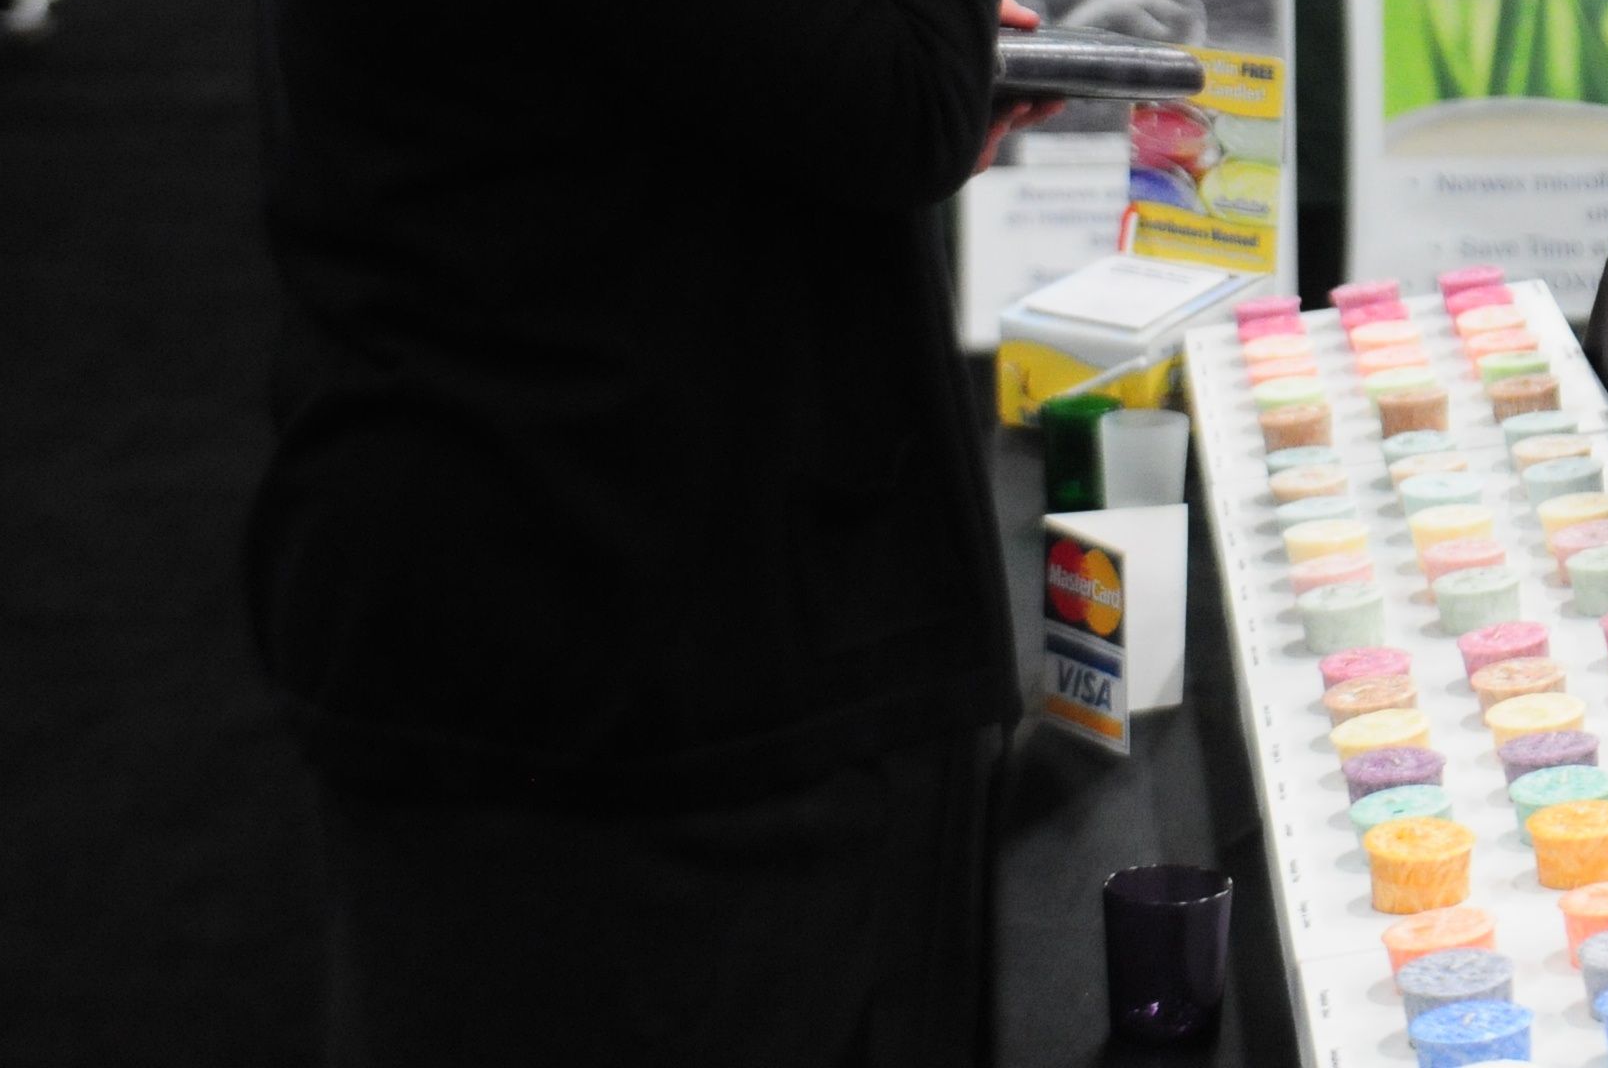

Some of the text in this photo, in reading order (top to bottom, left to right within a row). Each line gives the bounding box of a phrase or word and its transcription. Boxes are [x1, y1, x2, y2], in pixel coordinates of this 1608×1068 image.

[1240, 61, 1275, 81] FREE
[1049, 562, 1122, 610] MasterCard
[1055, 658, 1112, 711] VISA
